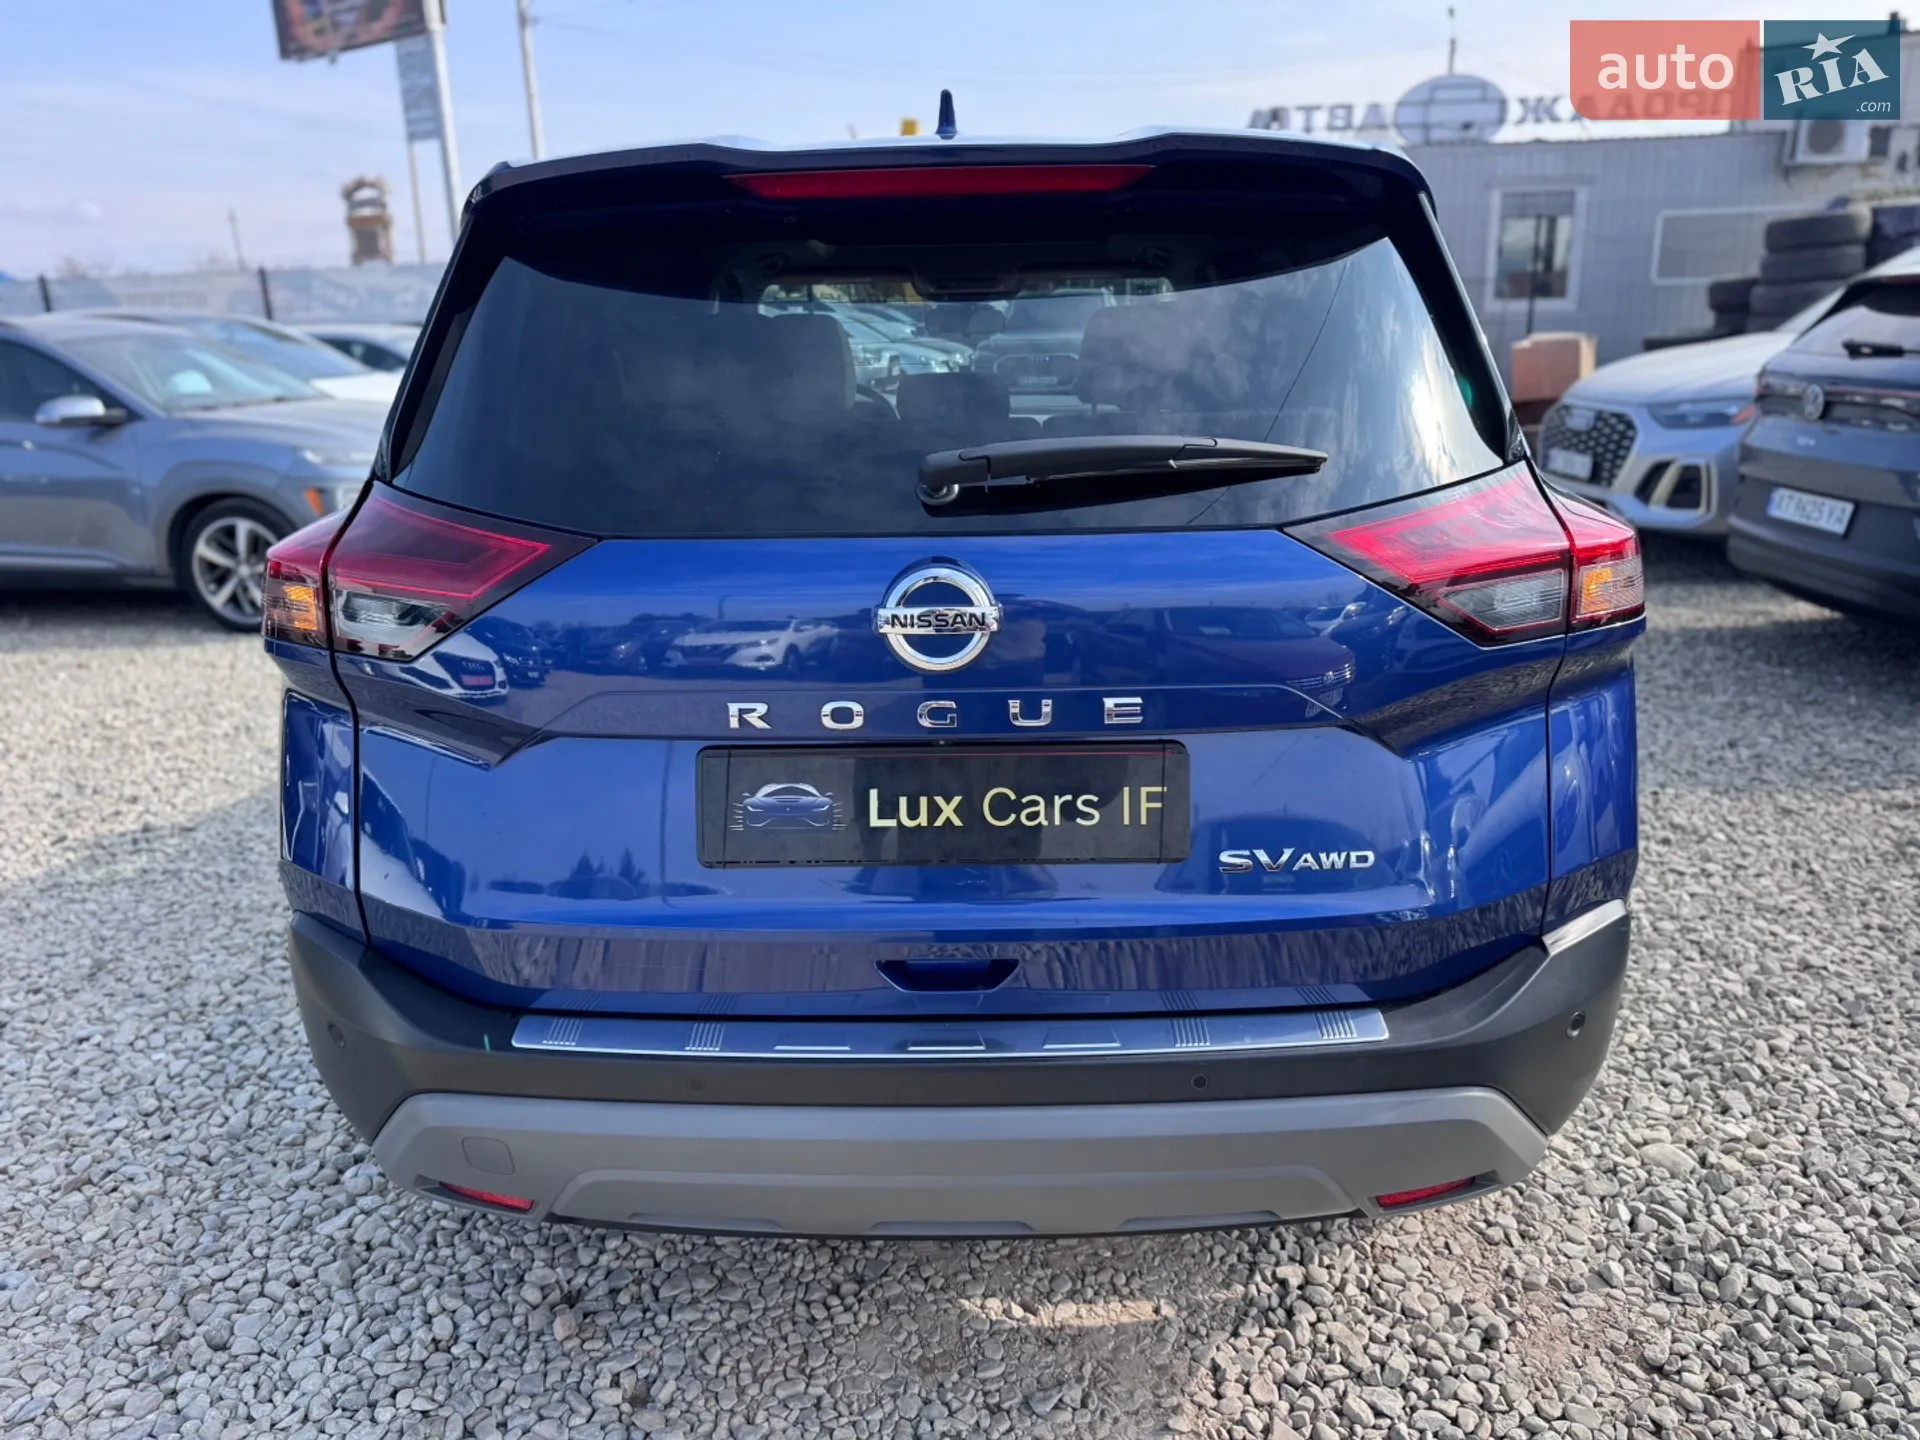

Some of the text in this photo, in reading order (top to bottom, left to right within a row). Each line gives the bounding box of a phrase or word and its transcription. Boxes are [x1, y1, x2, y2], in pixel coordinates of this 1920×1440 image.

[890, 611, 986, 629] NISSAN
[727, 697, 1144, 730] ROGUE
[869, 786, 1168, 828] Lux Cars IF
